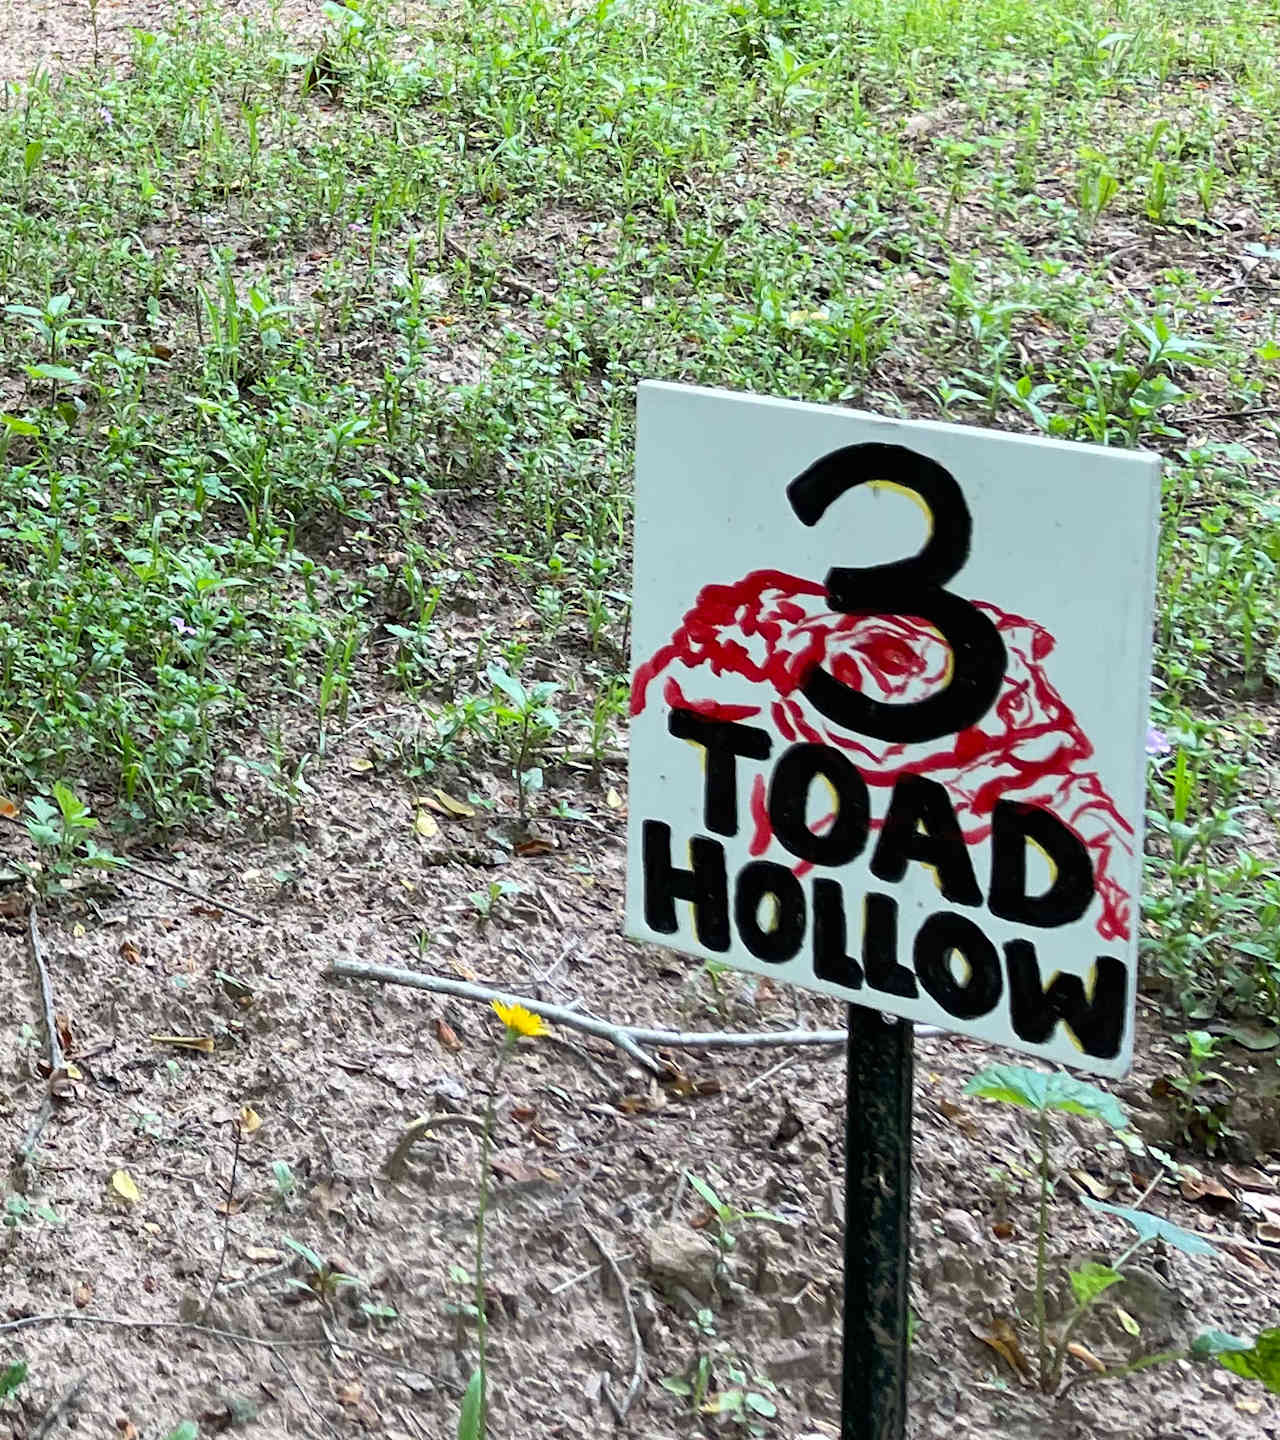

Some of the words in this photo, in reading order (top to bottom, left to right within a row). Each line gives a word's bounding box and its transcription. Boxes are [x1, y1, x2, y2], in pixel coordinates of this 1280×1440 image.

[786, 442, 1008, 743] 3
[668, 708, 1095, 929] TOAD
[642, 820, 1128, 1059] HOLLOW
